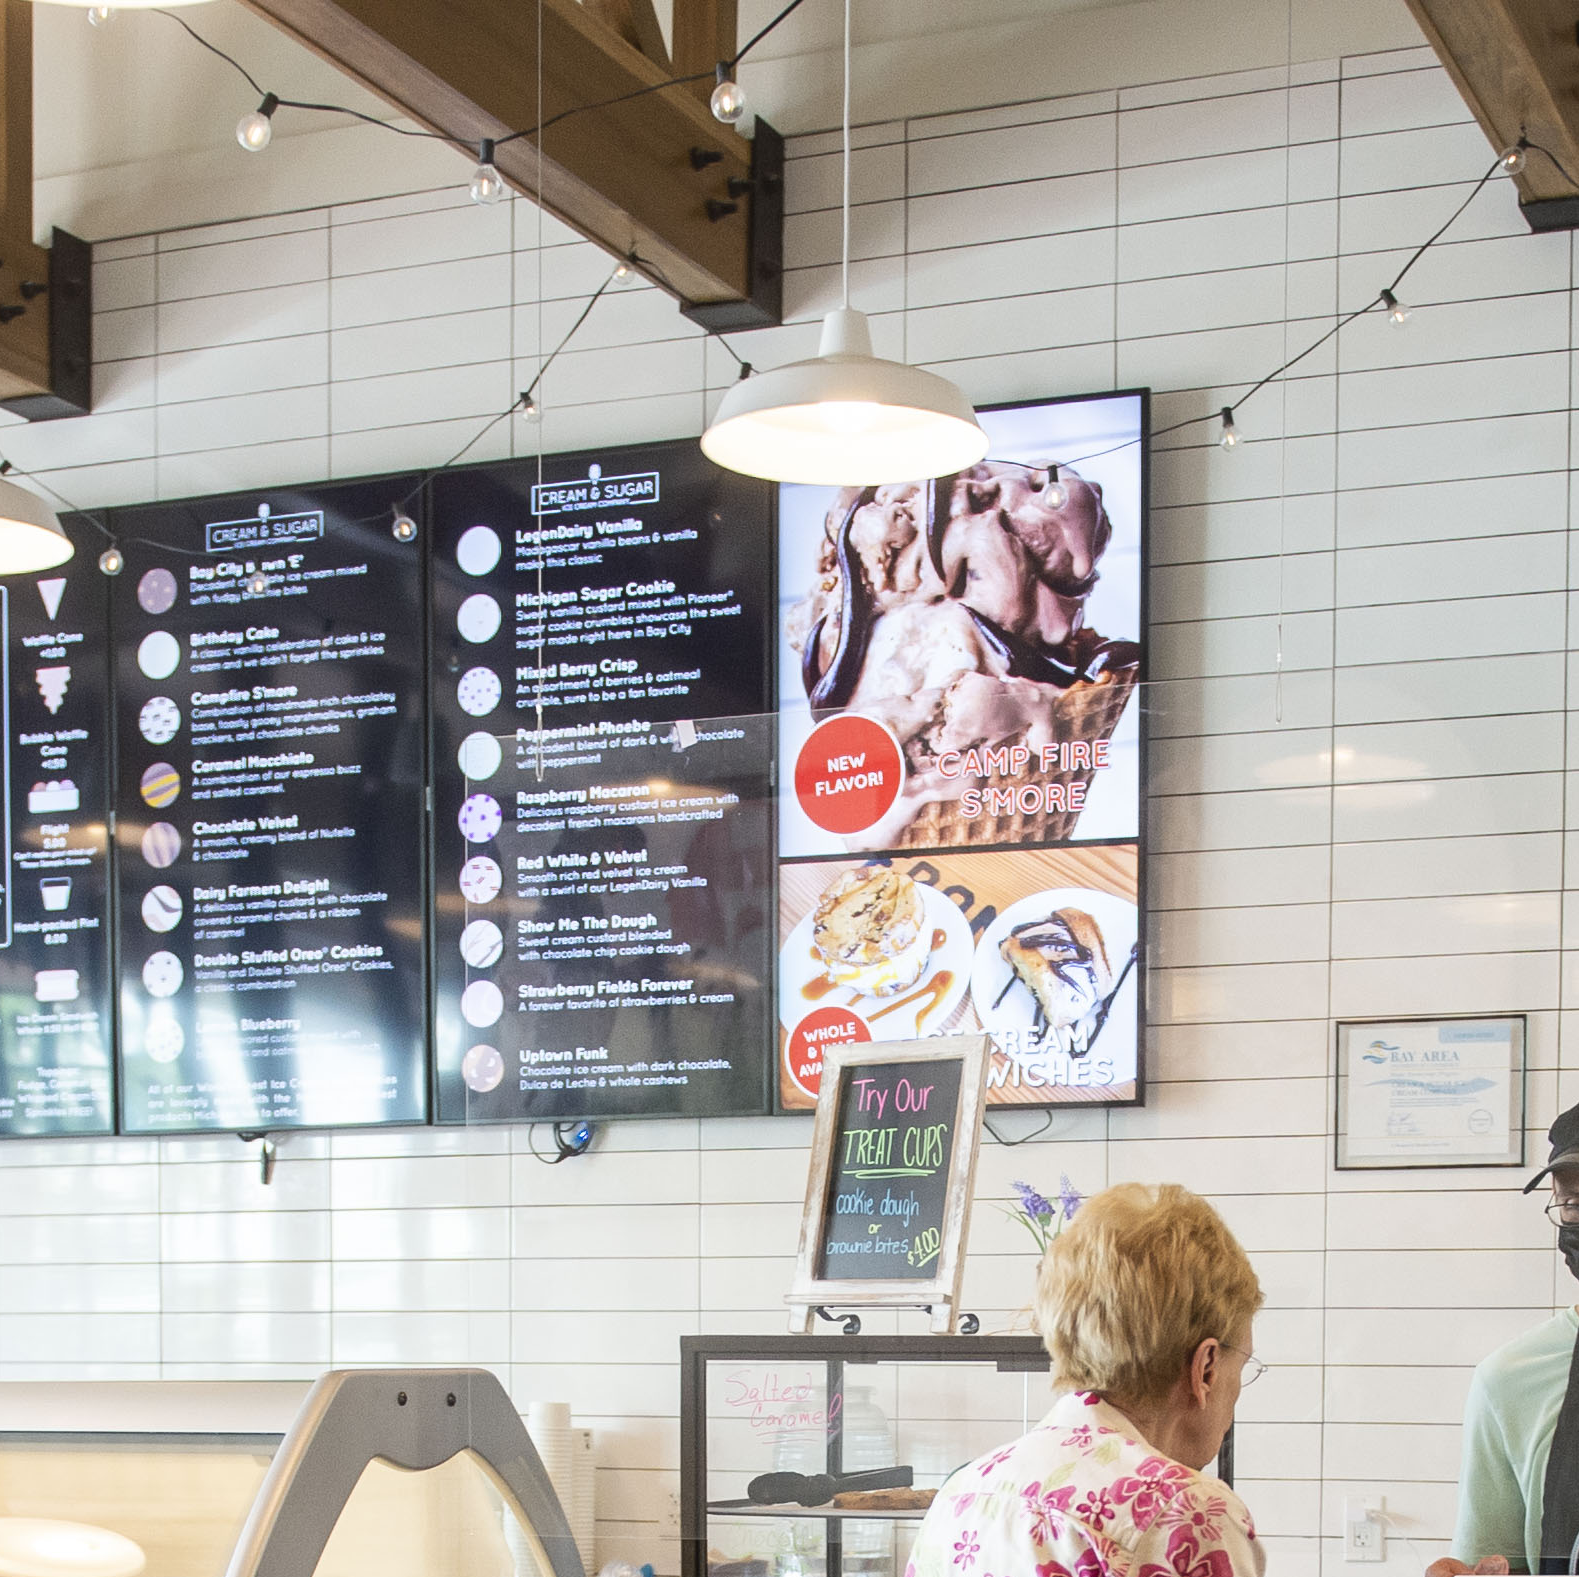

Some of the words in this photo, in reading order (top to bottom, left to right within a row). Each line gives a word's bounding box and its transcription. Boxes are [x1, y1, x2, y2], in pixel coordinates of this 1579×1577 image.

[540, 488, 587, 505] CREAM
[590, 486, 600, 499] &
[605, 481, 653, 498] SUGAR
[212, 527, 257, 543] CREAM
[260, 525, 269, 537] &
[273, 519, 318, 536] SUGAR
[516, 525, 593, 543] LegenDairy
[596, 518, 643, 534] Vanilla
[516, 591, 578, 607] Michigan
[581, 585, 623, 601] Sugar
[626, 580, 675, 596] Cookie
[190, 631, 244, 647] Birthday
[246, 627, 279, 640] Cake
[516, 664, 557, 680] Mixed
[559, 662, 597, 678] Berry
[600, 658, 638, 674] Crisp
[191, 689, 251, 706] Campfire
[516, 723, 596, 742] Peppermint
[599, 720, 651, 735] Phoebe
[192, 757, 247, 774] Caramel
[248, 752, 314, 768] Macchiato
[827, 752, 866, 774] NEW
[938, 745, 1029, 778] CAMP
[1040, 741, 1110, 774] FIRE
[815, 772, 884, 796] FLAVOR!
[517, 789, 586, 807] Raspberry
[590, 785, 649, 800] Macaron
[961, 782, 1087, 818] S'MORE
[192, 820, 257, 835] Chocolate
[258, 814, 299, 829] Velvet
[517, 856, 543, 870] Red
[547, 853, 588, 868] White
[590, 852, 601, 865] &
[604, 849, 647, 864] Velvet
[193, 887, 226, 900] Dairy
[228, 884, 281, 898] Farmers
[283, 879, 329, 895] Delight
[518, 918, 554, 933] Show
[558, 918, 579, 931] Me
[582, 916, 608, 929] The
[611, 914, 657, 929] Dough
[194, 954, 238, 967] Double
[242, 950, 288, 964] Stuffed
[331, 944, 383, 959] Cookies
[519, 984, 594, 998] Strawberry
[597, 980, 638, 994] Fields
[641, 978, 693, 992] Forever
[241, 1018, 301, 1031] Blueberry
[803, 1022, 856, 1041] WHOLE
[519, 1049, 573, 1064] Uptown
[576, 1047, 608, 1060] Funk
[1390, 1052, 1415, 1062] BAY
[1421, 1052, 1460, 1062] AREA
[520, 1065, 571, 1077] Chocolate
[573, 1064, 589, 1074] ice
[591, 1064, 624, 1074] cream
[626, 1062, 648, 1072] with
[650, 1060, 675, 1071] dark
[987, 1058, 1115, 1088] WICHES
[520, 1079, 549, 1090] Dulce
[550, 1078, 564, 1089] de
[566, 1078, 597, 1088] Leche
[608, 1076, 640, 1086] whole
[643, 1074, 688, 1085] cashews
[853, 1078, 887, 1119] Try
[895, 1078, 934, 1113] Our
[843, 1129, 896, 1166] TREAT
[902, 1124, 949, 1167] CUPS
[836, 1188, 874, 1216] cookie
[880, 1190, 919, 1227] dough
[868, 1222, 882, 1235] or
[827, 1237, 872, 1255] brownie
[875, 1238, 909, 1255] bites
[725, 1370, 812, 1402] Salted
[750, 1393, 842, 1428] Caramel
